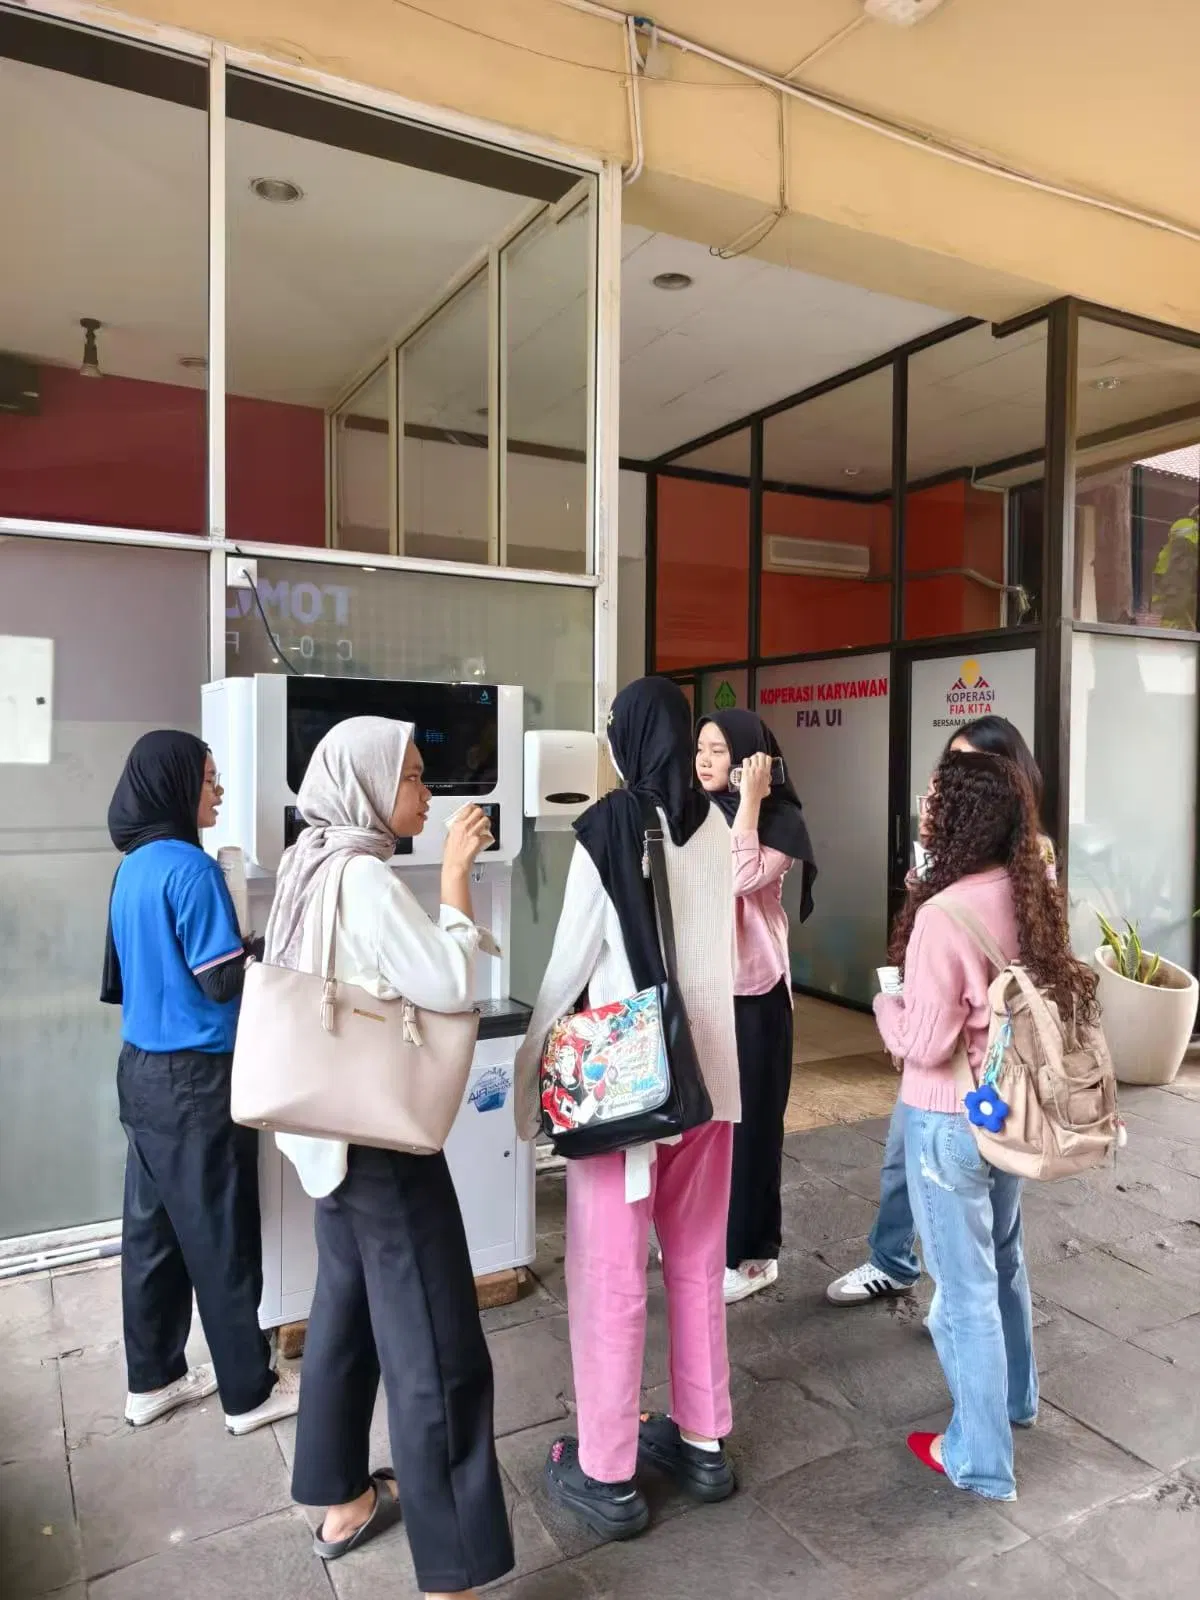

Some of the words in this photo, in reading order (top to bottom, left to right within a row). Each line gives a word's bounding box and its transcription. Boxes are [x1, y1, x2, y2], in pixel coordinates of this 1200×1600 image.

[761, 687, 814, 705] KOPERASI
[817, 678, 888, 702] KARYAWAN
[946, 690, 995, 704] KOPERASI
[949, 704, 965, 715] FIA
[968, 703, 992, 715] KITA
[796, 709, 821, 728] FIA
[826, 708, 842, 727] UI
